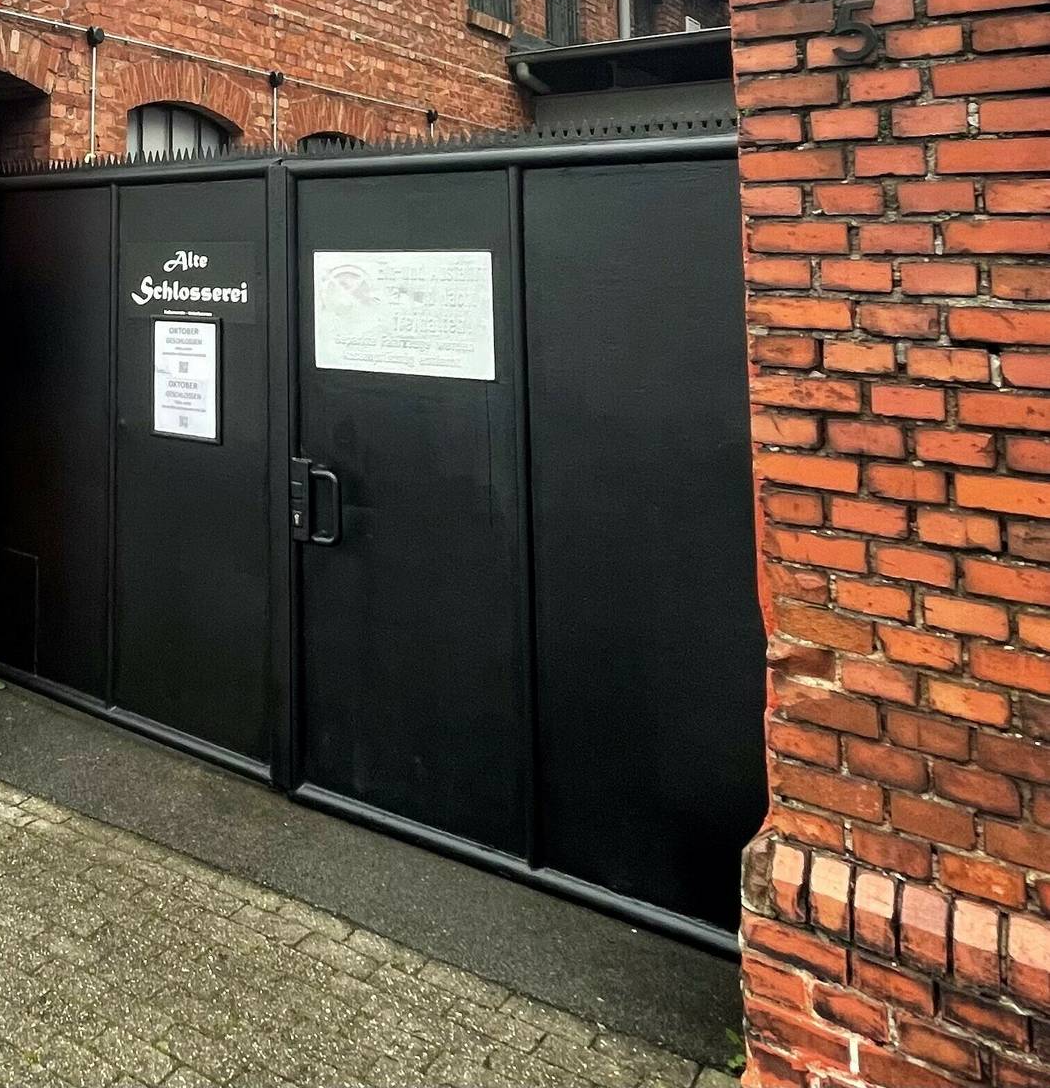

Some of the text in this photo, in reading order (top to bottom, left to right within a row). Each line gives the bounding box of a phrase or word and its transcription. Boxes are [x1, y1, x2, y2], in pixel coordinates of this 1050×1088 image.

[163, 250, 209, 272] Alte
[131, 276, 248, 305] Schlosserei
[168, 327, 199, 335] OKTOBER
[168, 380, 198, 390] OKTOBER
